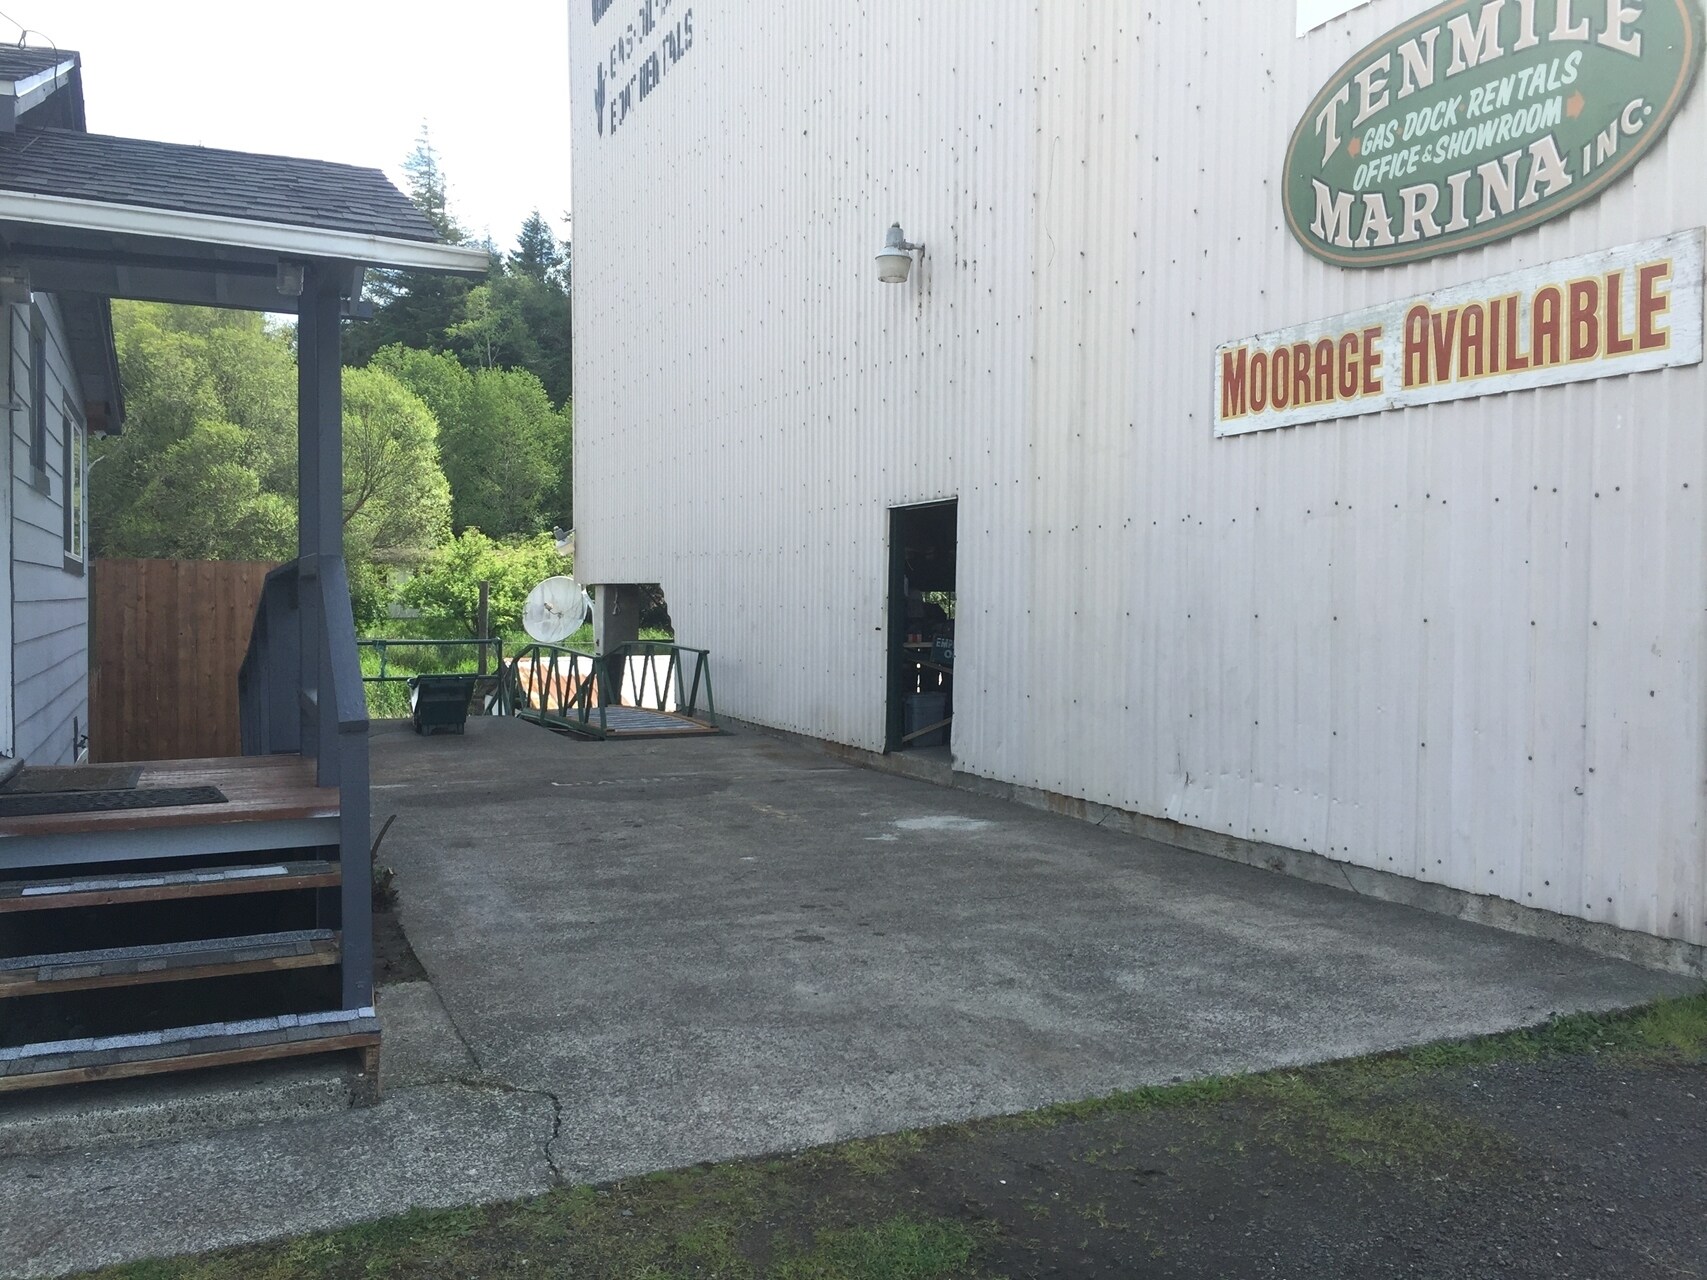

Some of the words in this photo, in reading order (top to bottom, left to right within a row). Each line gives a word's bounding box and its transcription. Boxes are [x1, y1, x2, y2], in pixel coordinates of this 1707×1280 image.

[1315, 0, 1642, 168] TENMILE
[1353, 144, 1421, 191] OFFICE
[1433, 95, 1562, 164] SHOWROOM
[1361, 119, 1399, 156] GAS
[1401, 94, 1464, 141] DOCK
[1466, 50, 1582, 119] RENTALS
[1310, 134, 1573, 247] MARINA
[1582, 98, 1652, 176] INC.
[1221, 326, 1383, 419] MOORAGE
[1403, 261, 1671, 391] AVAILABLE
